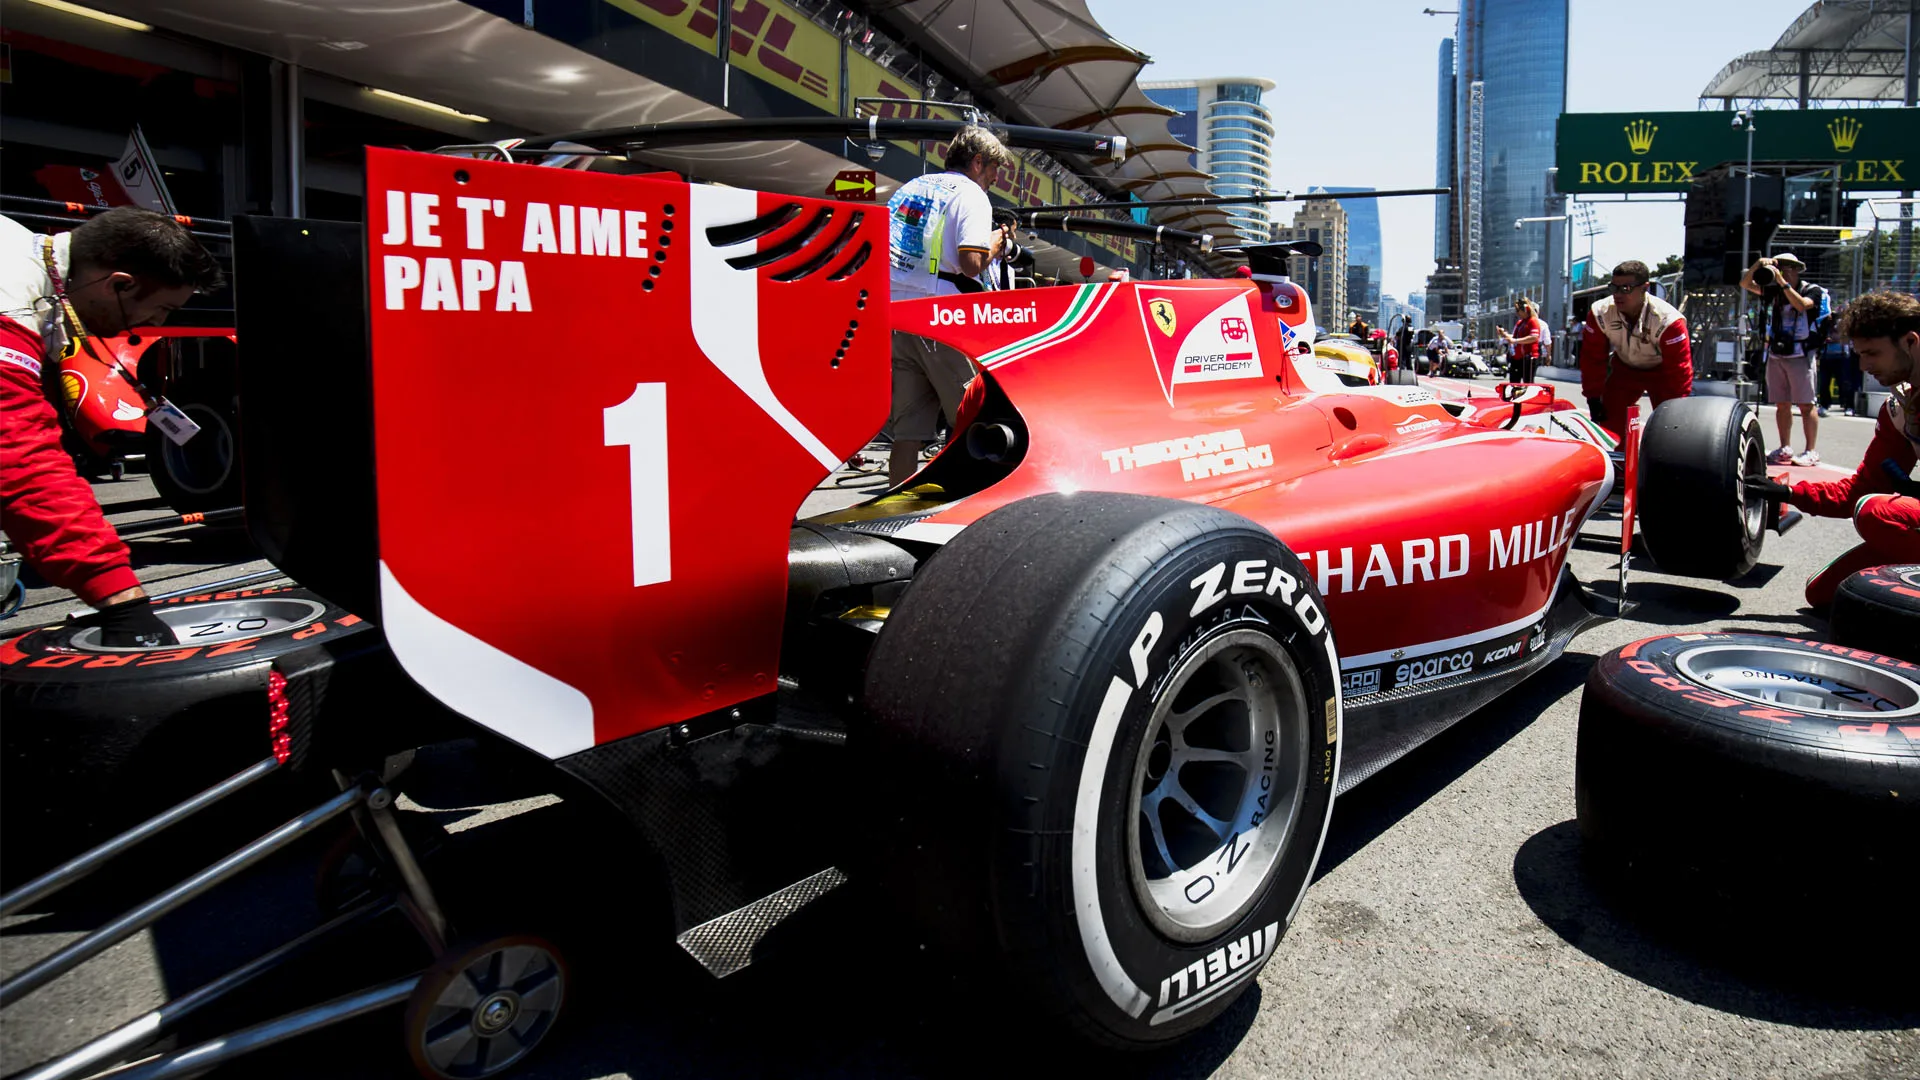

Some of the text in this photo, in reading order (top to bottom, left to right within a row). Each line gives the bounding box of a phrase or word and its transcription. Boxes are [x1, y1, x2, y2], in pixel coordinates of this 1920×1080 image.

[124, 158, 141, 181] 5
[1579, 161, 1699, 184] ROLEX
[1822, 159, 1905, 182] LEX
[382, 190, 649, 259] JE T' AIME
[383, 255, 533, 313] PAPA
[929, 301, 1037, 326] Joe Macari
[1184, 353, 1225, 364] DRIVER
[1203, 360, 1252, 372] ACADEMY
[602, 382, 671, 587] 1
[1296, 508, 1576, 597] HARD MILLE
[1129, 611, 1164, 689] P
[1189, 559, 1325, 636] ZERO
[26, 637, 262, 669] ZERO
[1482, 640, 1523, 665] KONI
[1395, 651, 1473, 686] sparco
[1742, 670, 1822, 685] RACING
[1250, 729, 1275, 828] RACING
